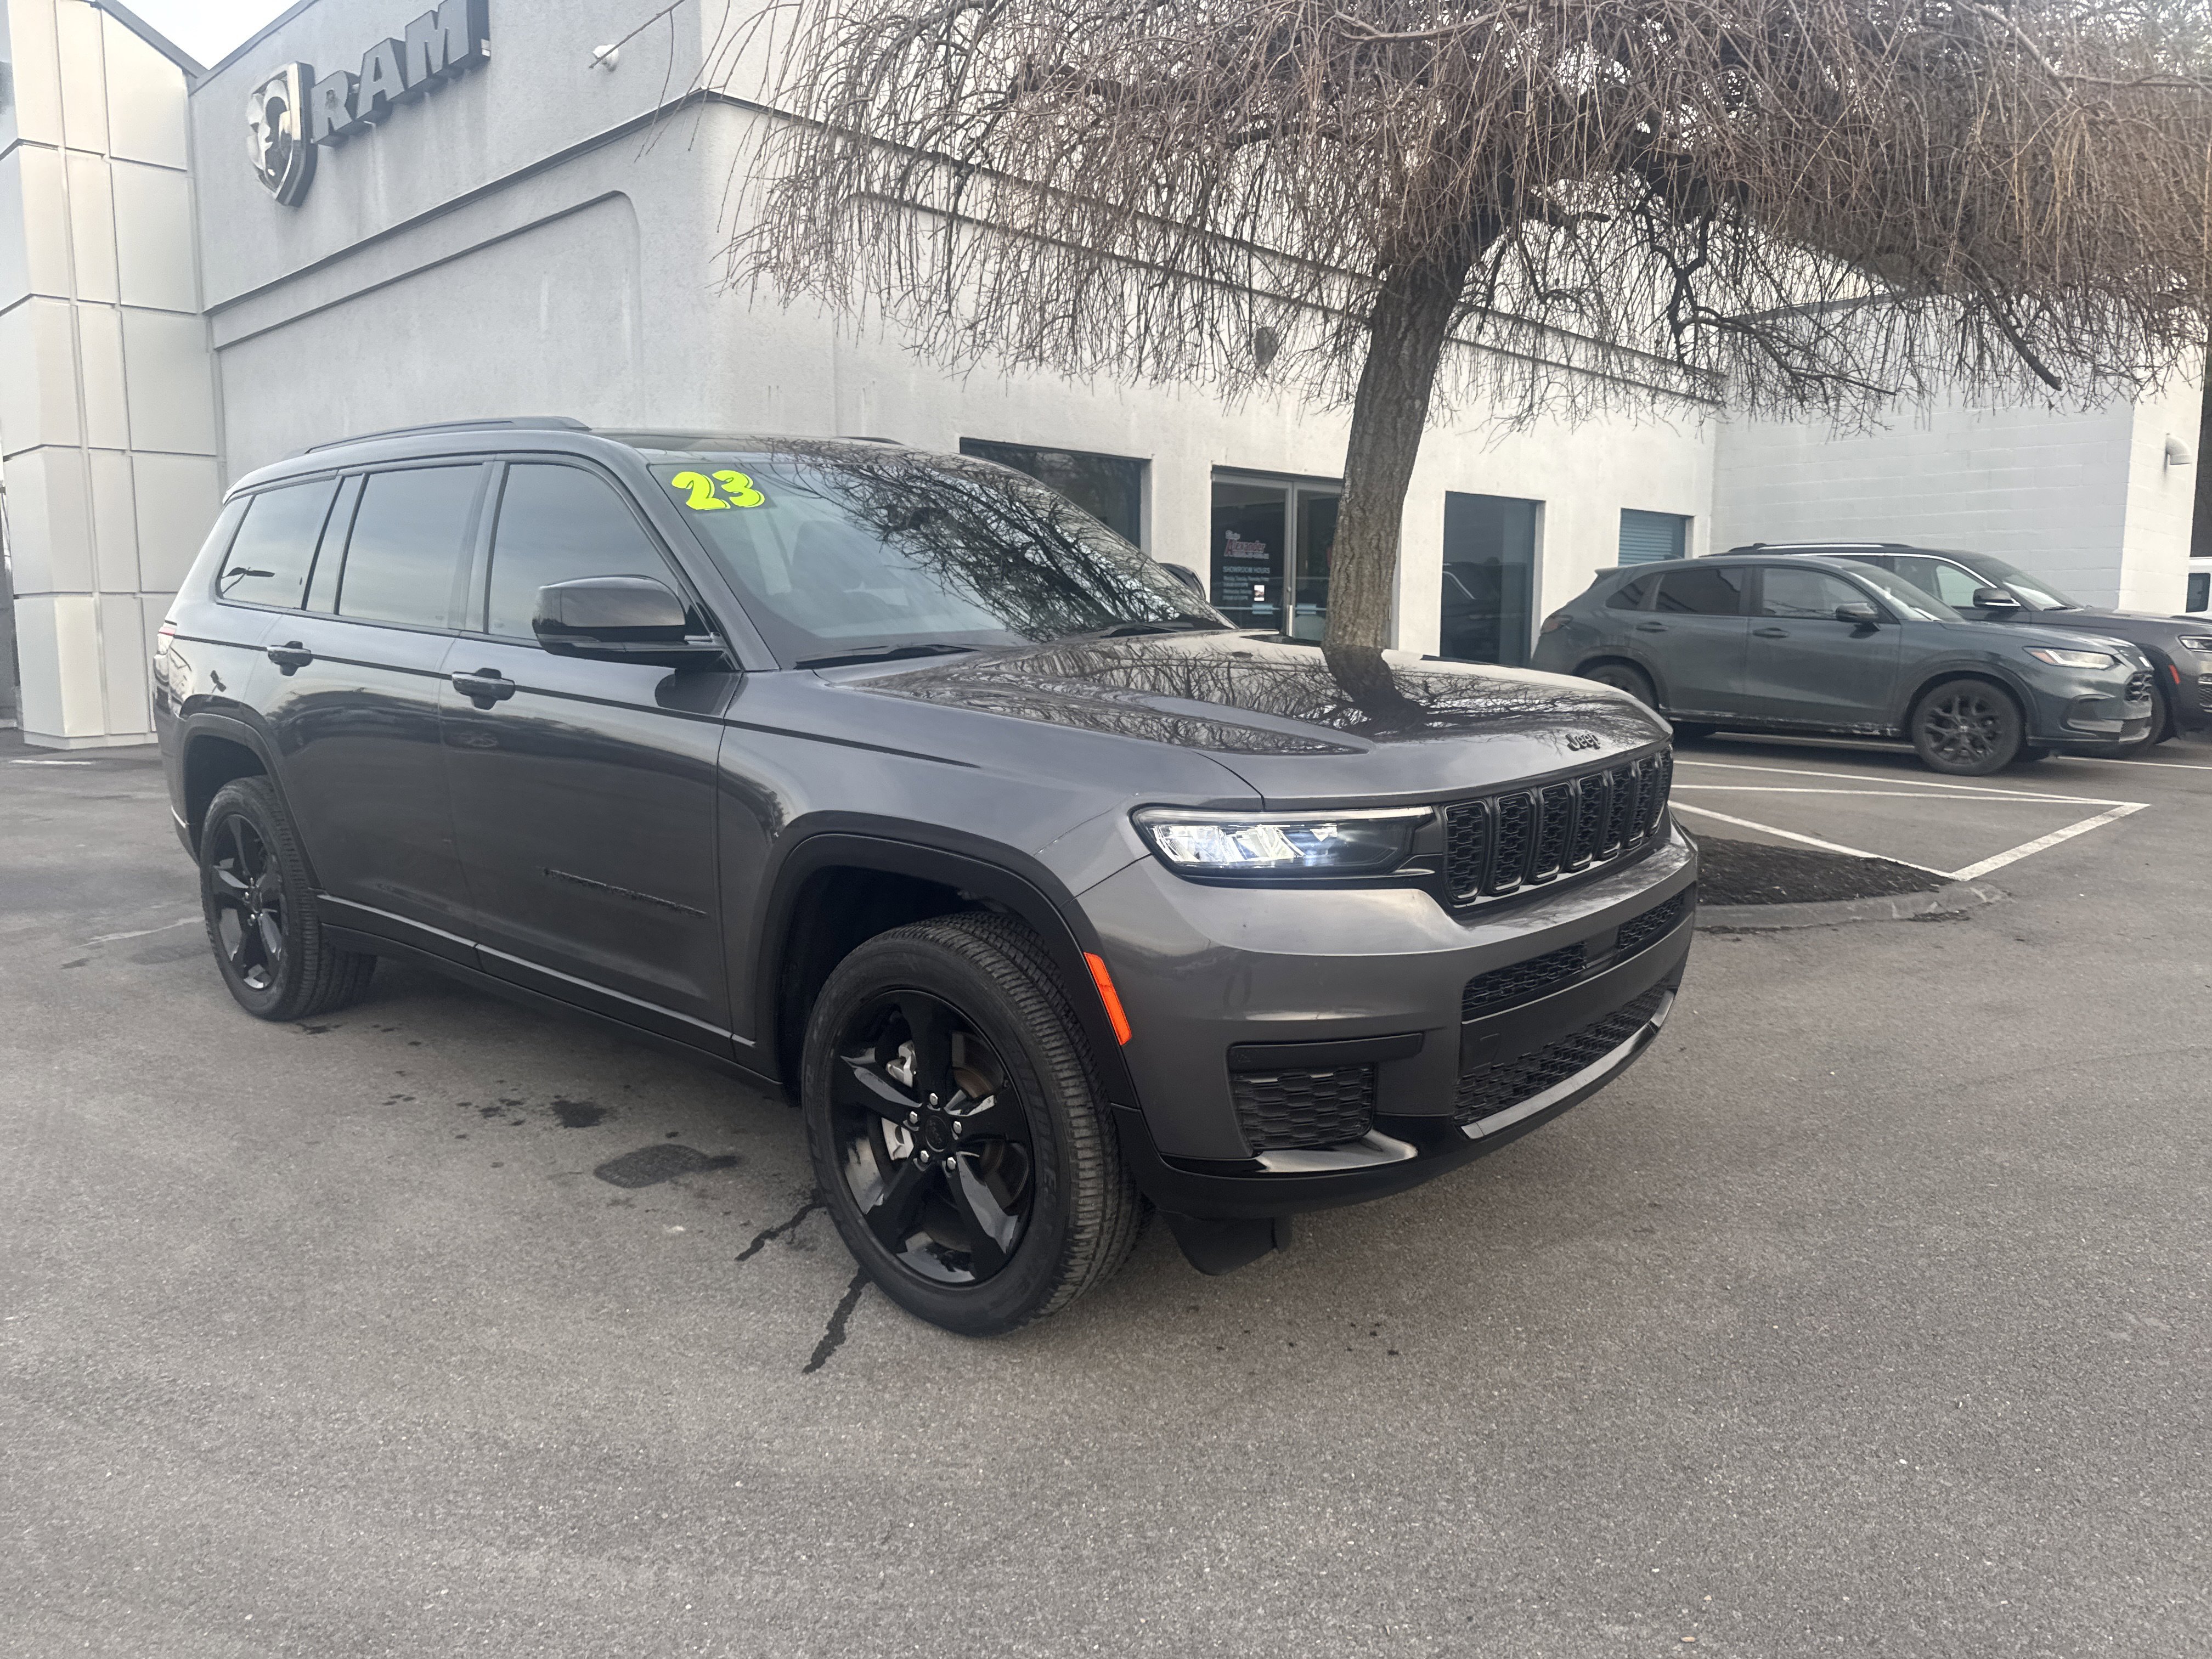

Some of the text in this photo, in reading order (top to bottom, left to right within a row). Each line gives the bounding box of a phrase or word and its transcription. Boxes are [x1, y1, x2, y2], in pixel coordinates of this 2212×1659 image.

[311, 0, 472, 144] RAM
[672, 470, 765, 510] 23
[1565, 733, 1601, 751] Jeep
